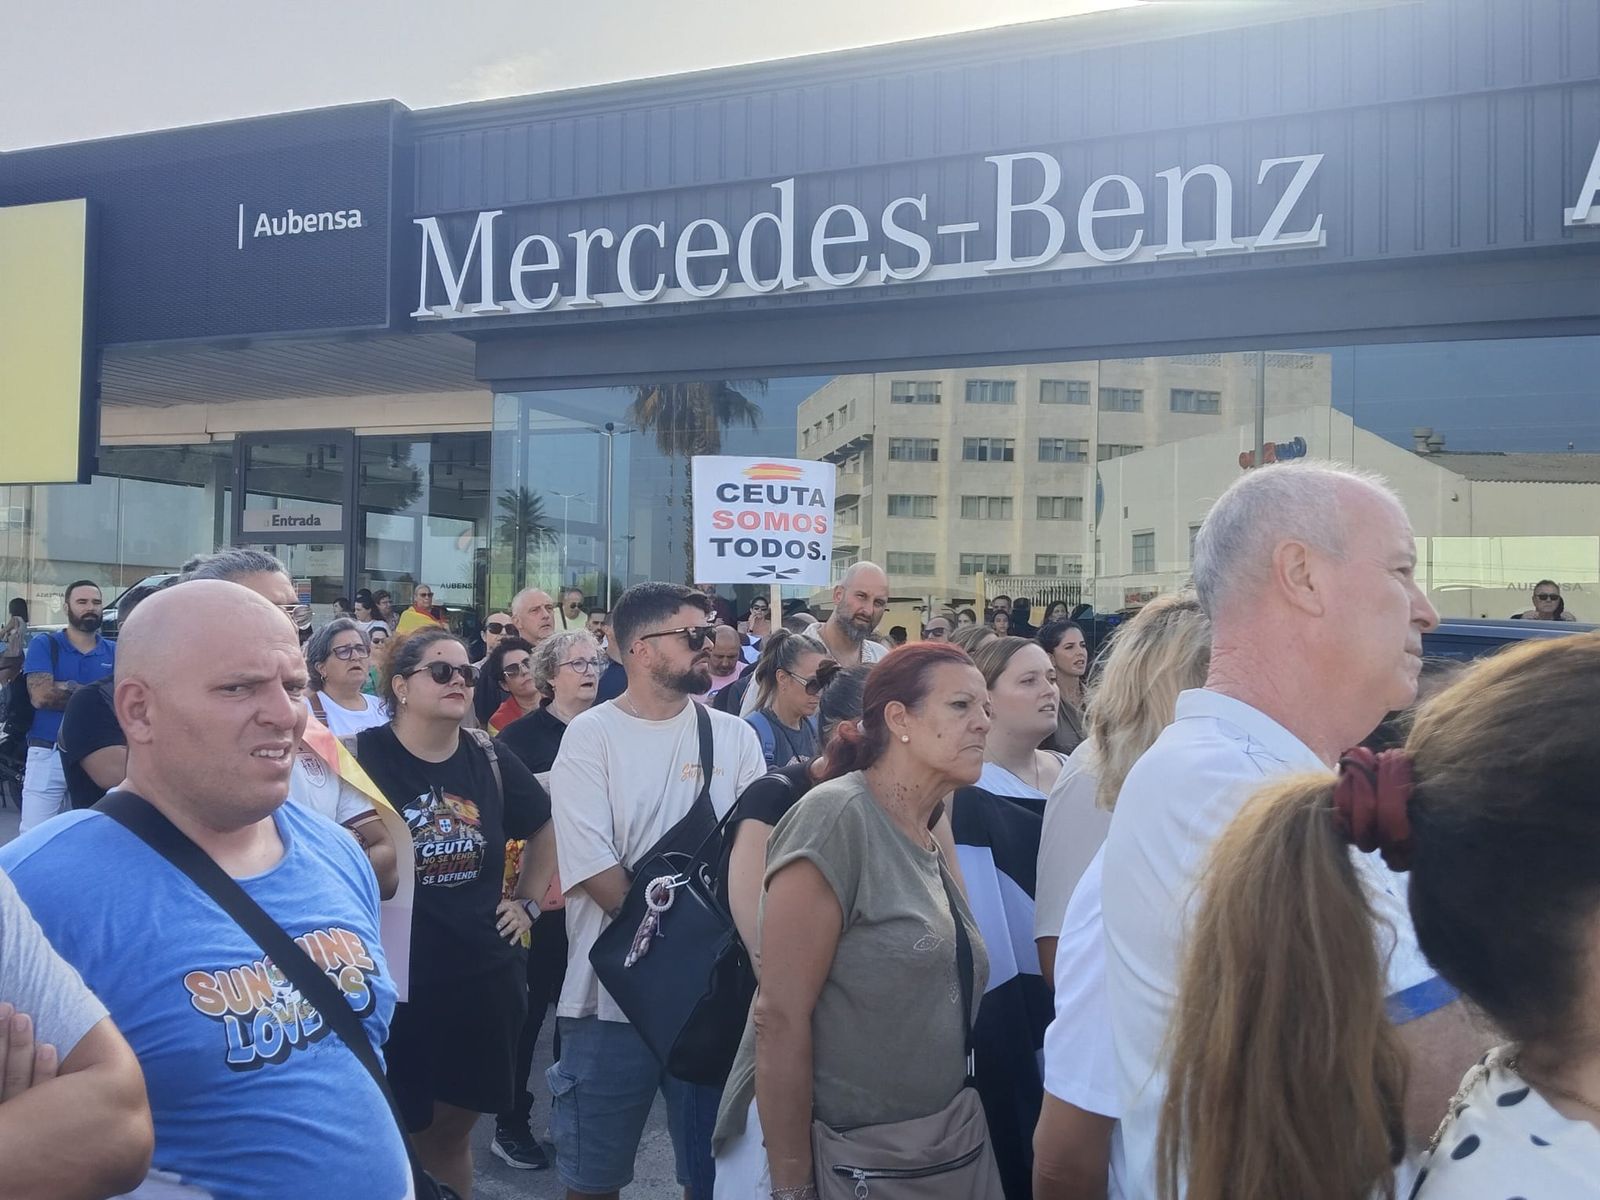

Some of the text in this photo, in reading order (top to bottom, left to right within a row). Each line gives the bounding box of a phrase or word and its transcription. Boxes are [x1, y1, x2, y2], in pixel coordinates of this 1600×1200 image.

[253, 208, 362, 238] Aubensa
[410, 151, 1326, 318] Mercedes-Benz
[716, 483, 826, 507] CEUTA
[271, 514, 322, 527] Entrada
[712, 510, 827, 534] SOMOS
[709, 538, 826, 561] TODOS.
[422, 839, 474, 857] CEUTA
[422, 857, 436, 865] NO
[438, 855, 449, 864] SE
[422, 870, 478, 885] SE DEFIENDE
